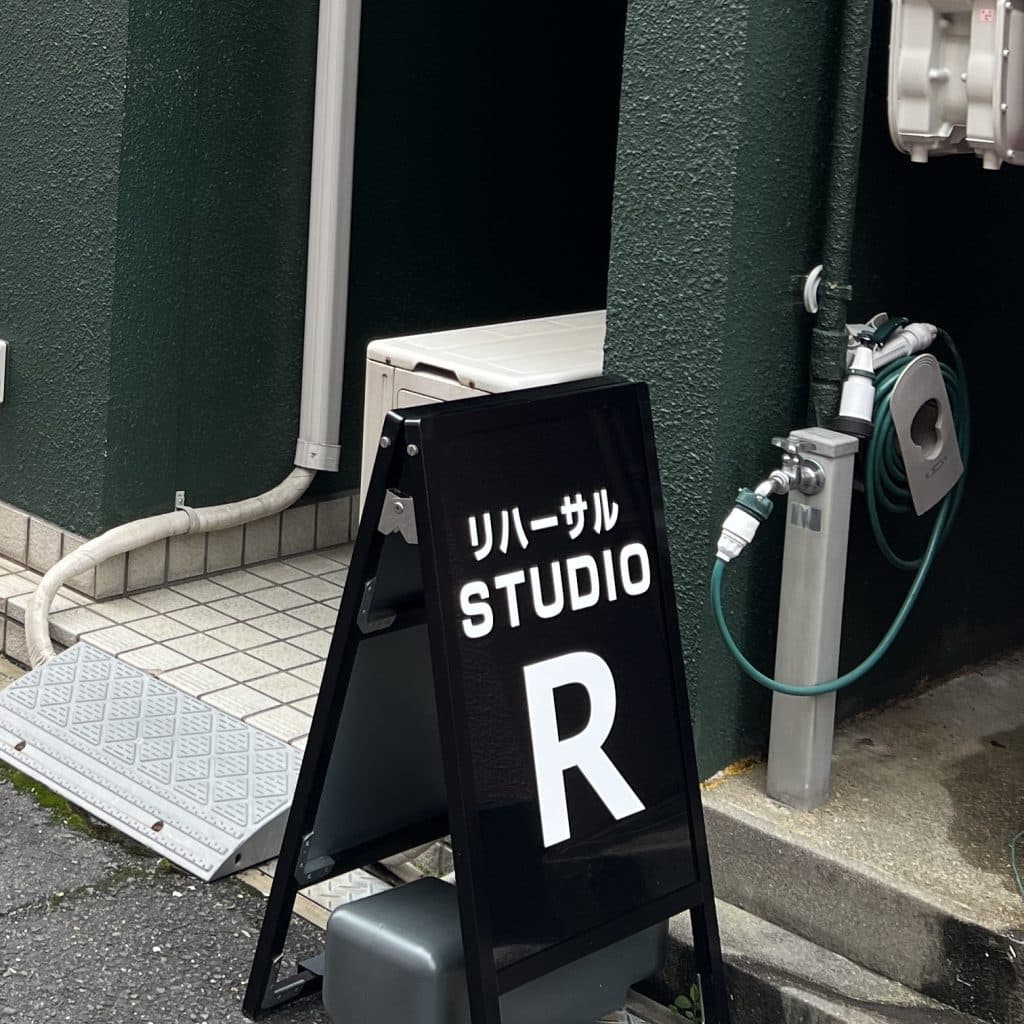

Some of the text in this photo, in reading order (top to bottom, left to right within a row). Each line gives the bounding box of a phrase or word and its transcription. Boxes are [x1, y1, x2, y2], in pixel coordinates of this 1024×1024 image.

[467, 488, 619, 562] リハーサル
[459, 542, 651, 639] STUDIO
[523, 651, 647, 848] R
